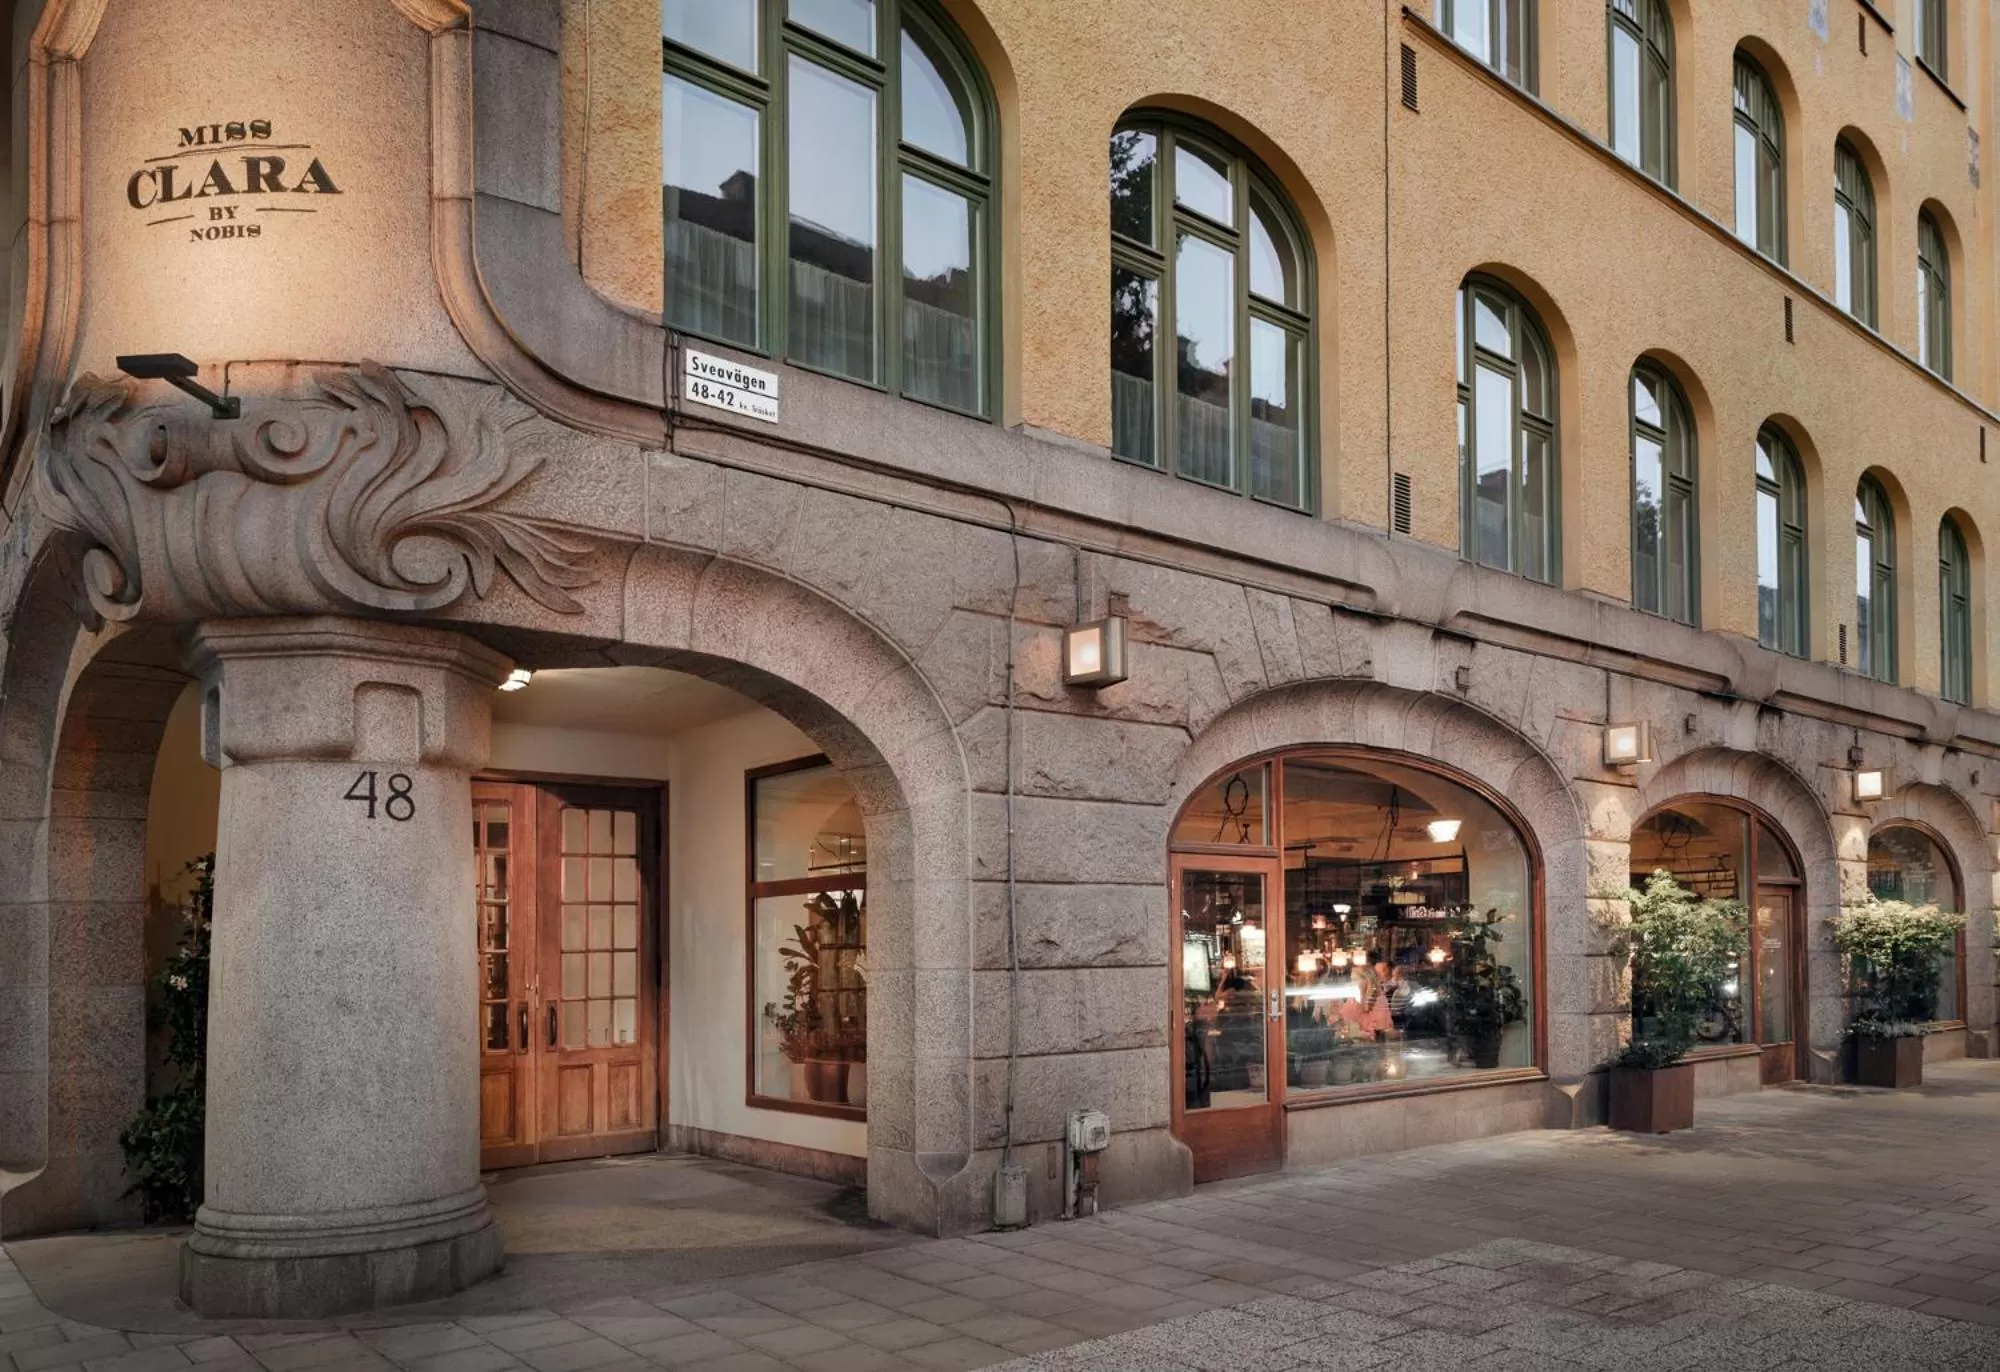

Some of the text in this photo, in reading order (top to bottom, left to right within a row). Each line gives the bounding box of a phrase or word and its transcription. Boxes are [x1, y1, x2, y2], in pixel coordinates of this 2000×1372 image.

[178, 119, 272, 148] MISS
[127, 155, 344, 209] CLARA
[208, 205, 240, 221] BY
[189, 224, 262, 242] NOBIS
[692, 356, 767, 391] Sveavägen
[691, 382, 735, 406] 48-42
[343, 771, 416, 822] 48
